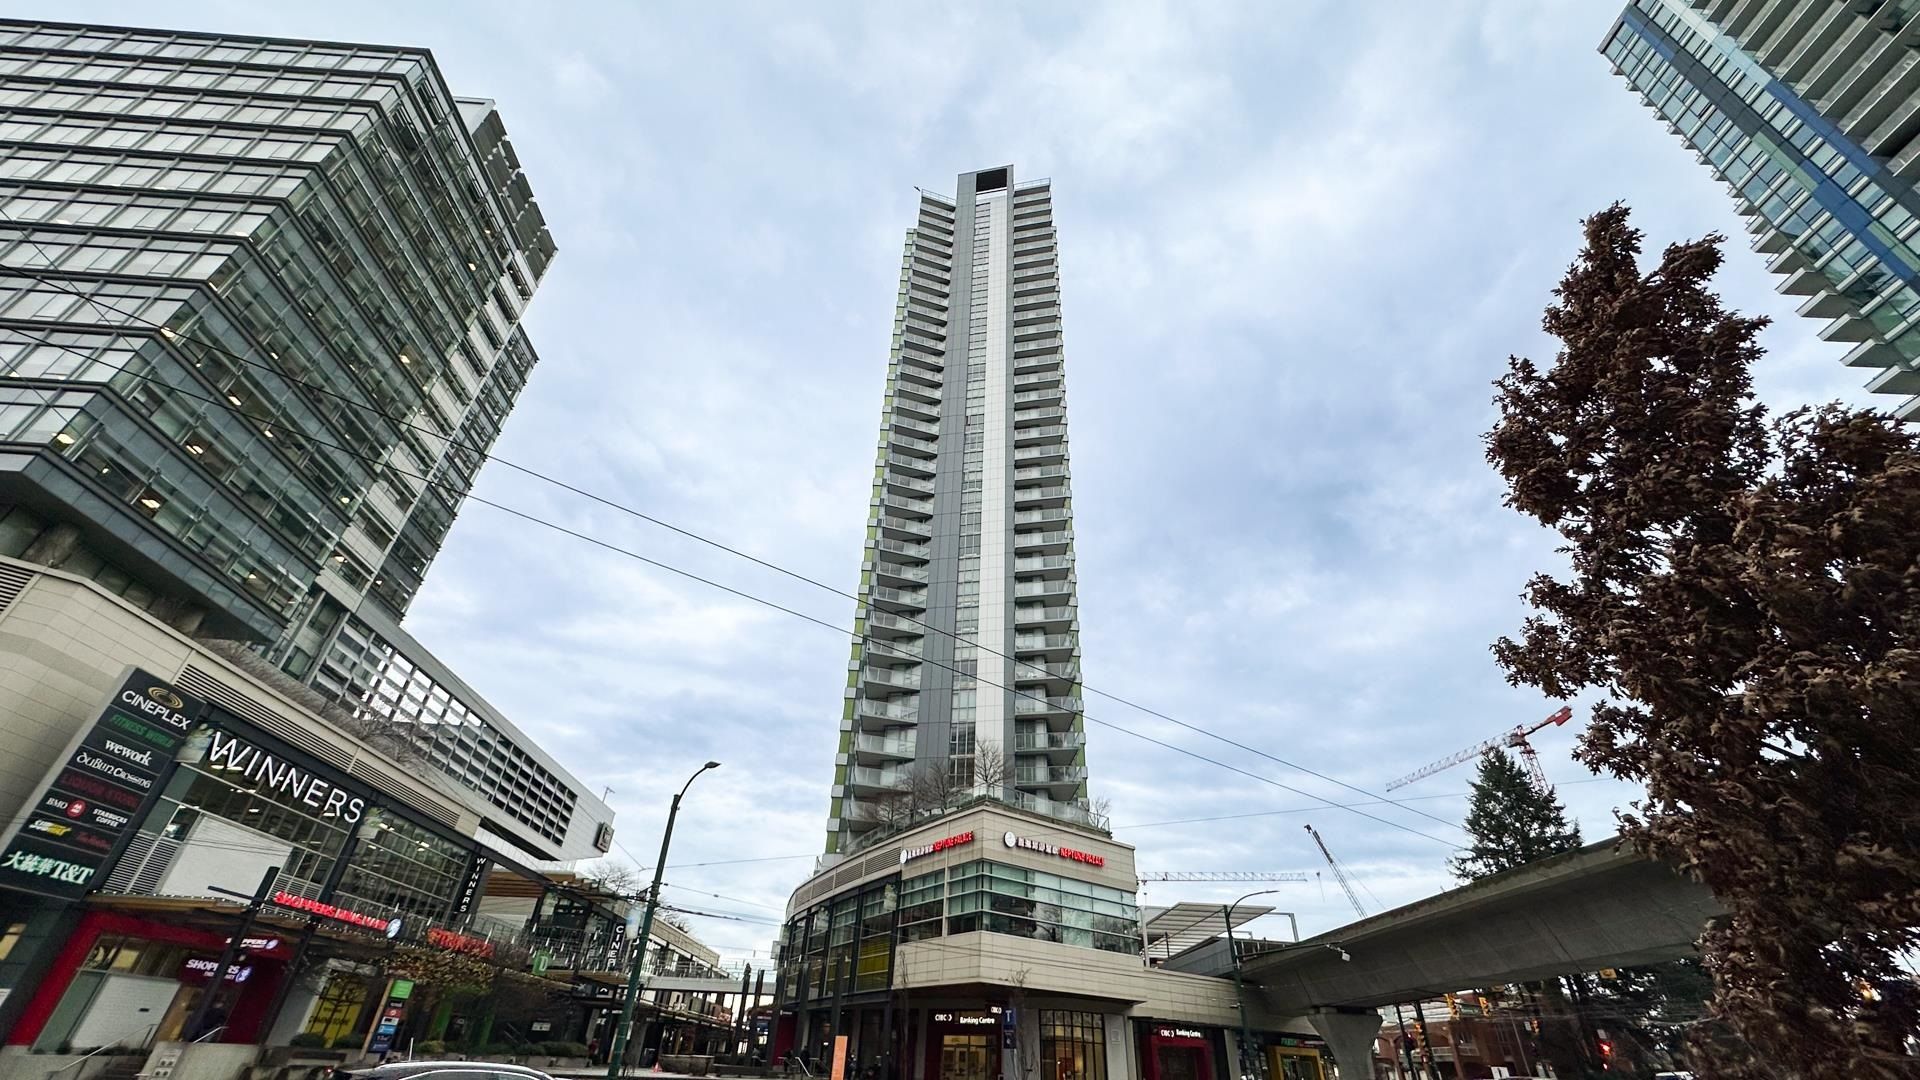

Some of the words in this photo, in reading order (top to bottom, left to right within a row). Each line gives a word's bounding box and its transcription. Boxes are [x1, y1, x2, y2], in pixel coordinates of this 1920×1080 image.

[122, 690, 191, 730] CINEPLEX
[112, 714, 147, 736] FITNESS
[104, 739, 152, 767] wework
[209, 731, 364, 823] WINNERS
[46, 797, 68, 810] BMO
[93, 807, 128, 825] STARBUCKS
[95, 815, 120, 828] COFFEE
[460, 857, 487, 912] WINNERS
[273, 890, 337, 917] SHOPPERS
[934, 1013, 947, 1022] CIBC
[959, 1016, 979, 1025] Banking
[979, 1016, 995, 1024] Centre
